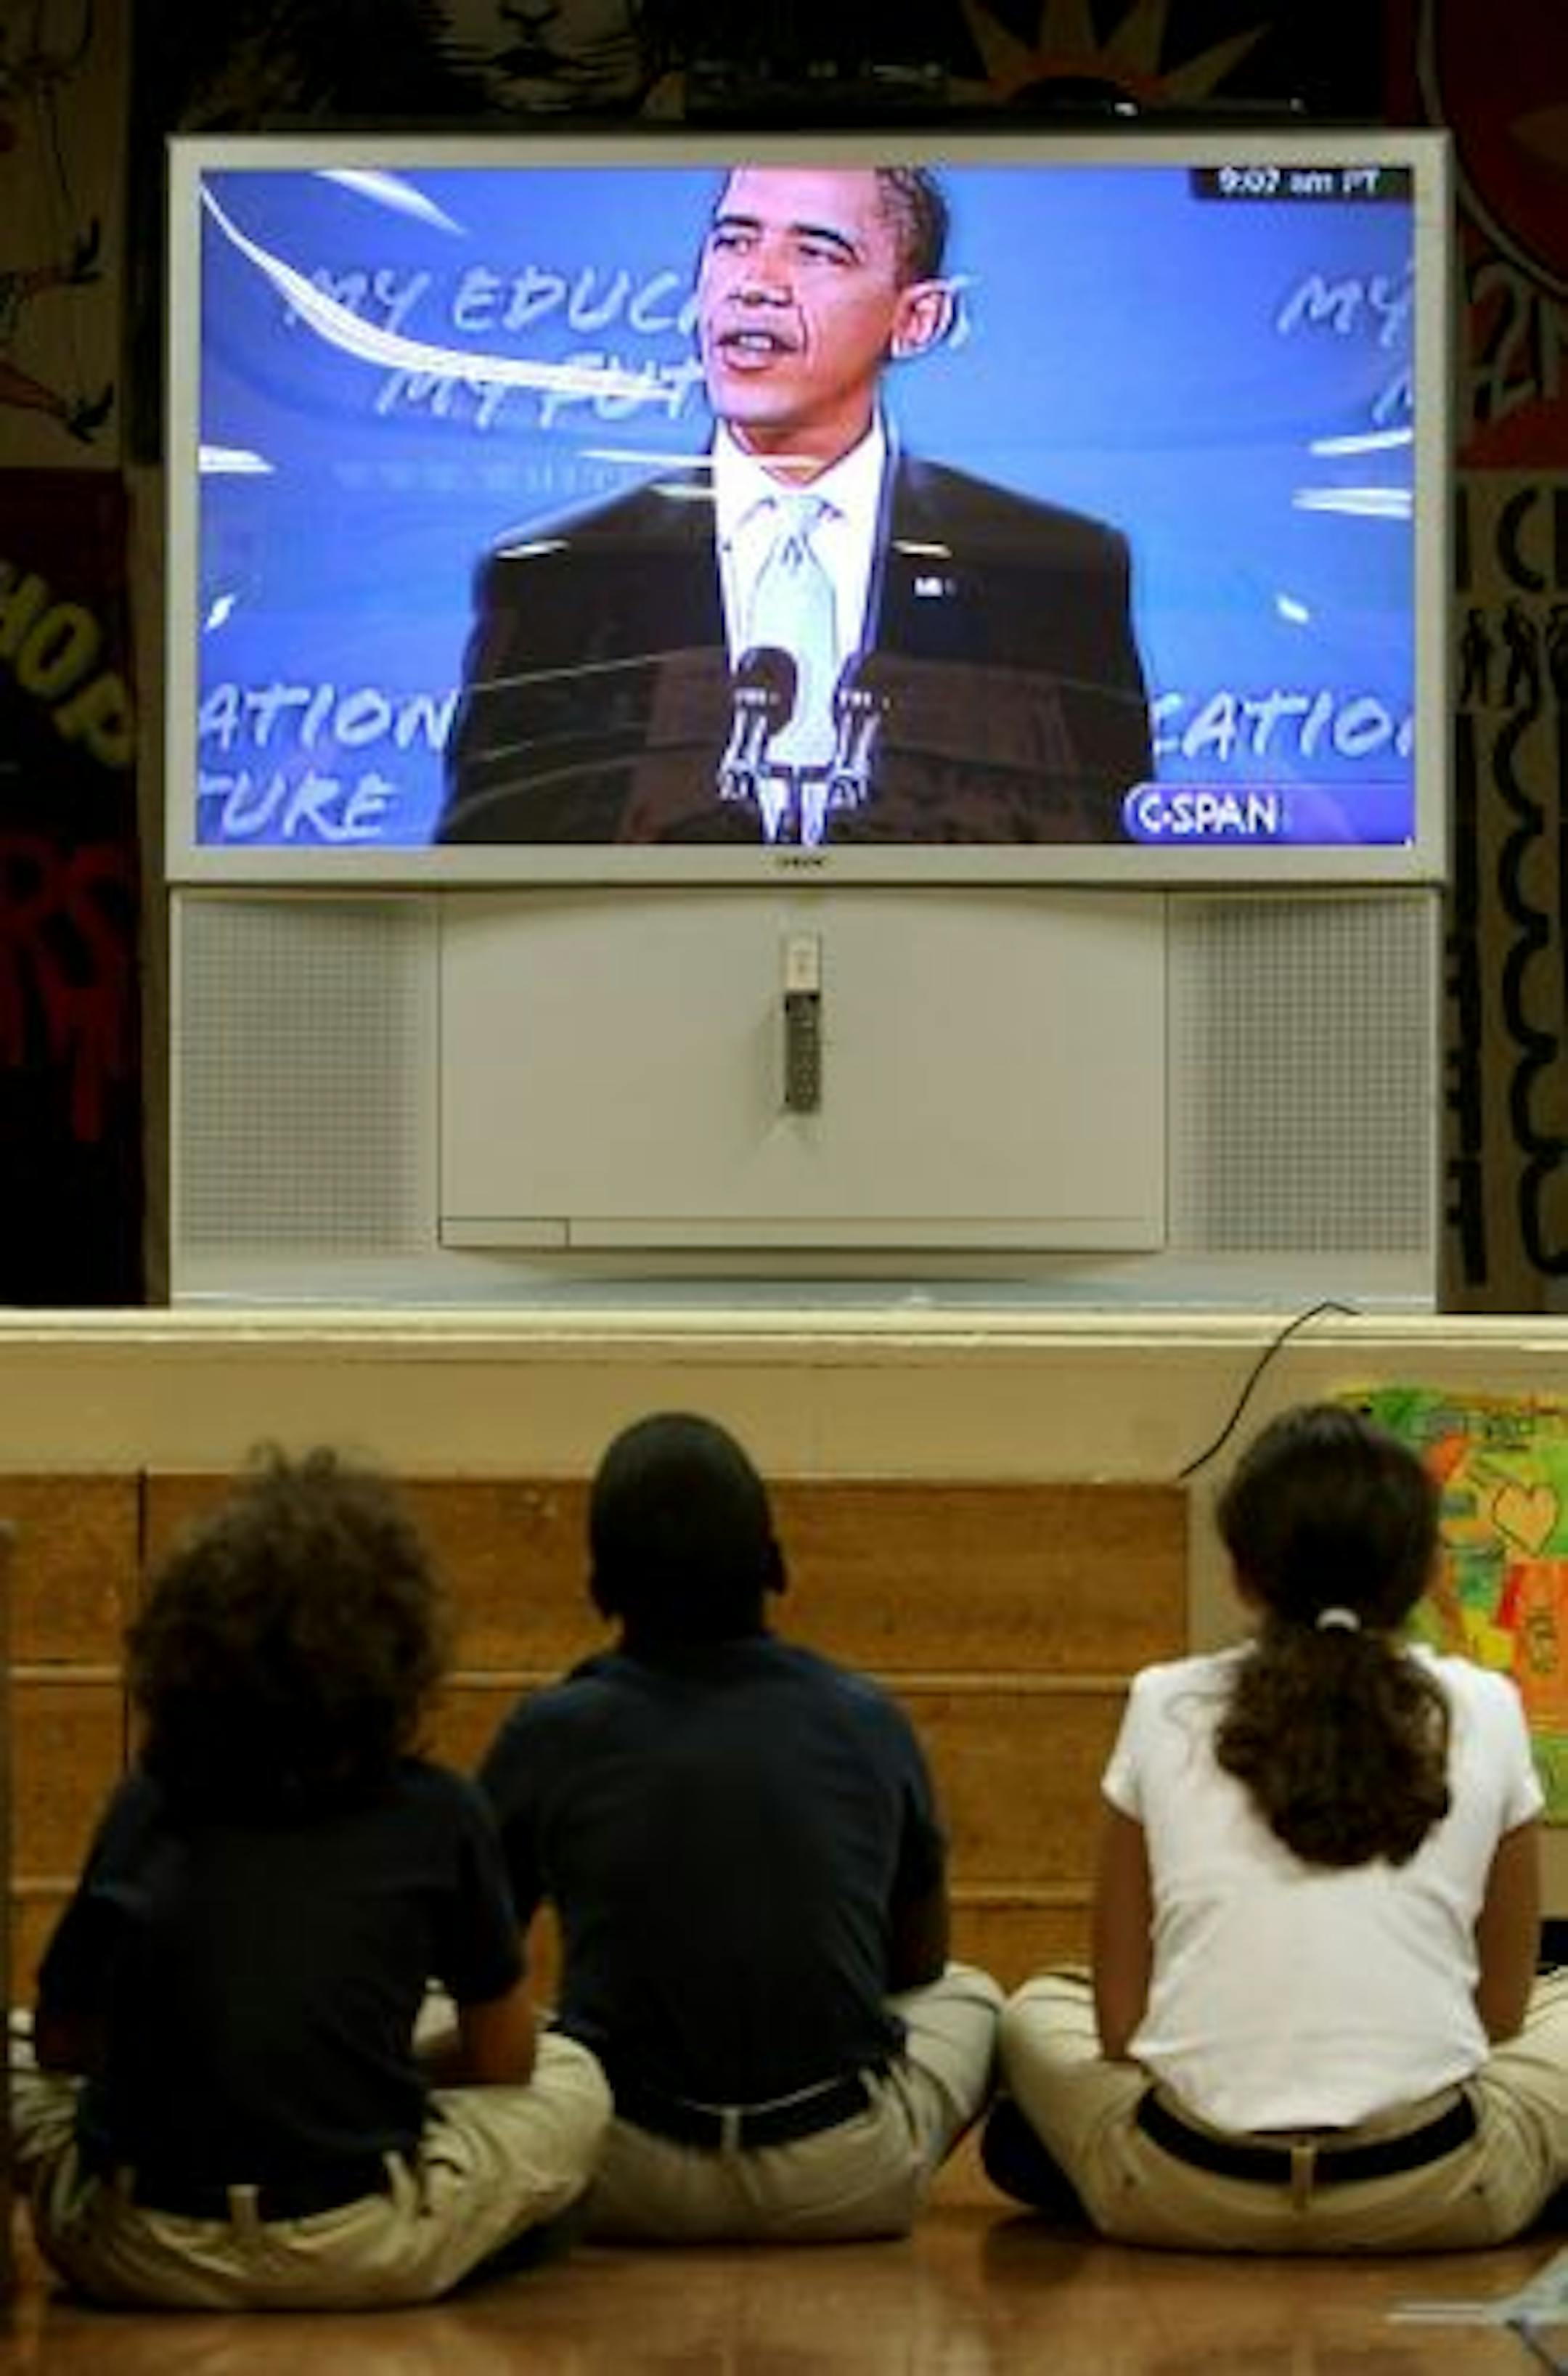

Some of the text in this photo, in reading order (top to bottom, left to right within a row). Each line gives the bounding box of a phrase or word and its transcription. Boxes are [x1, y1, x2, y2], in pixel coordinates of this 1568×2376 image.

[1290, 171, 1334, 194] am
[1343, 168, 1379, 194] PT
[1277, 261, 1413, 348] MY
